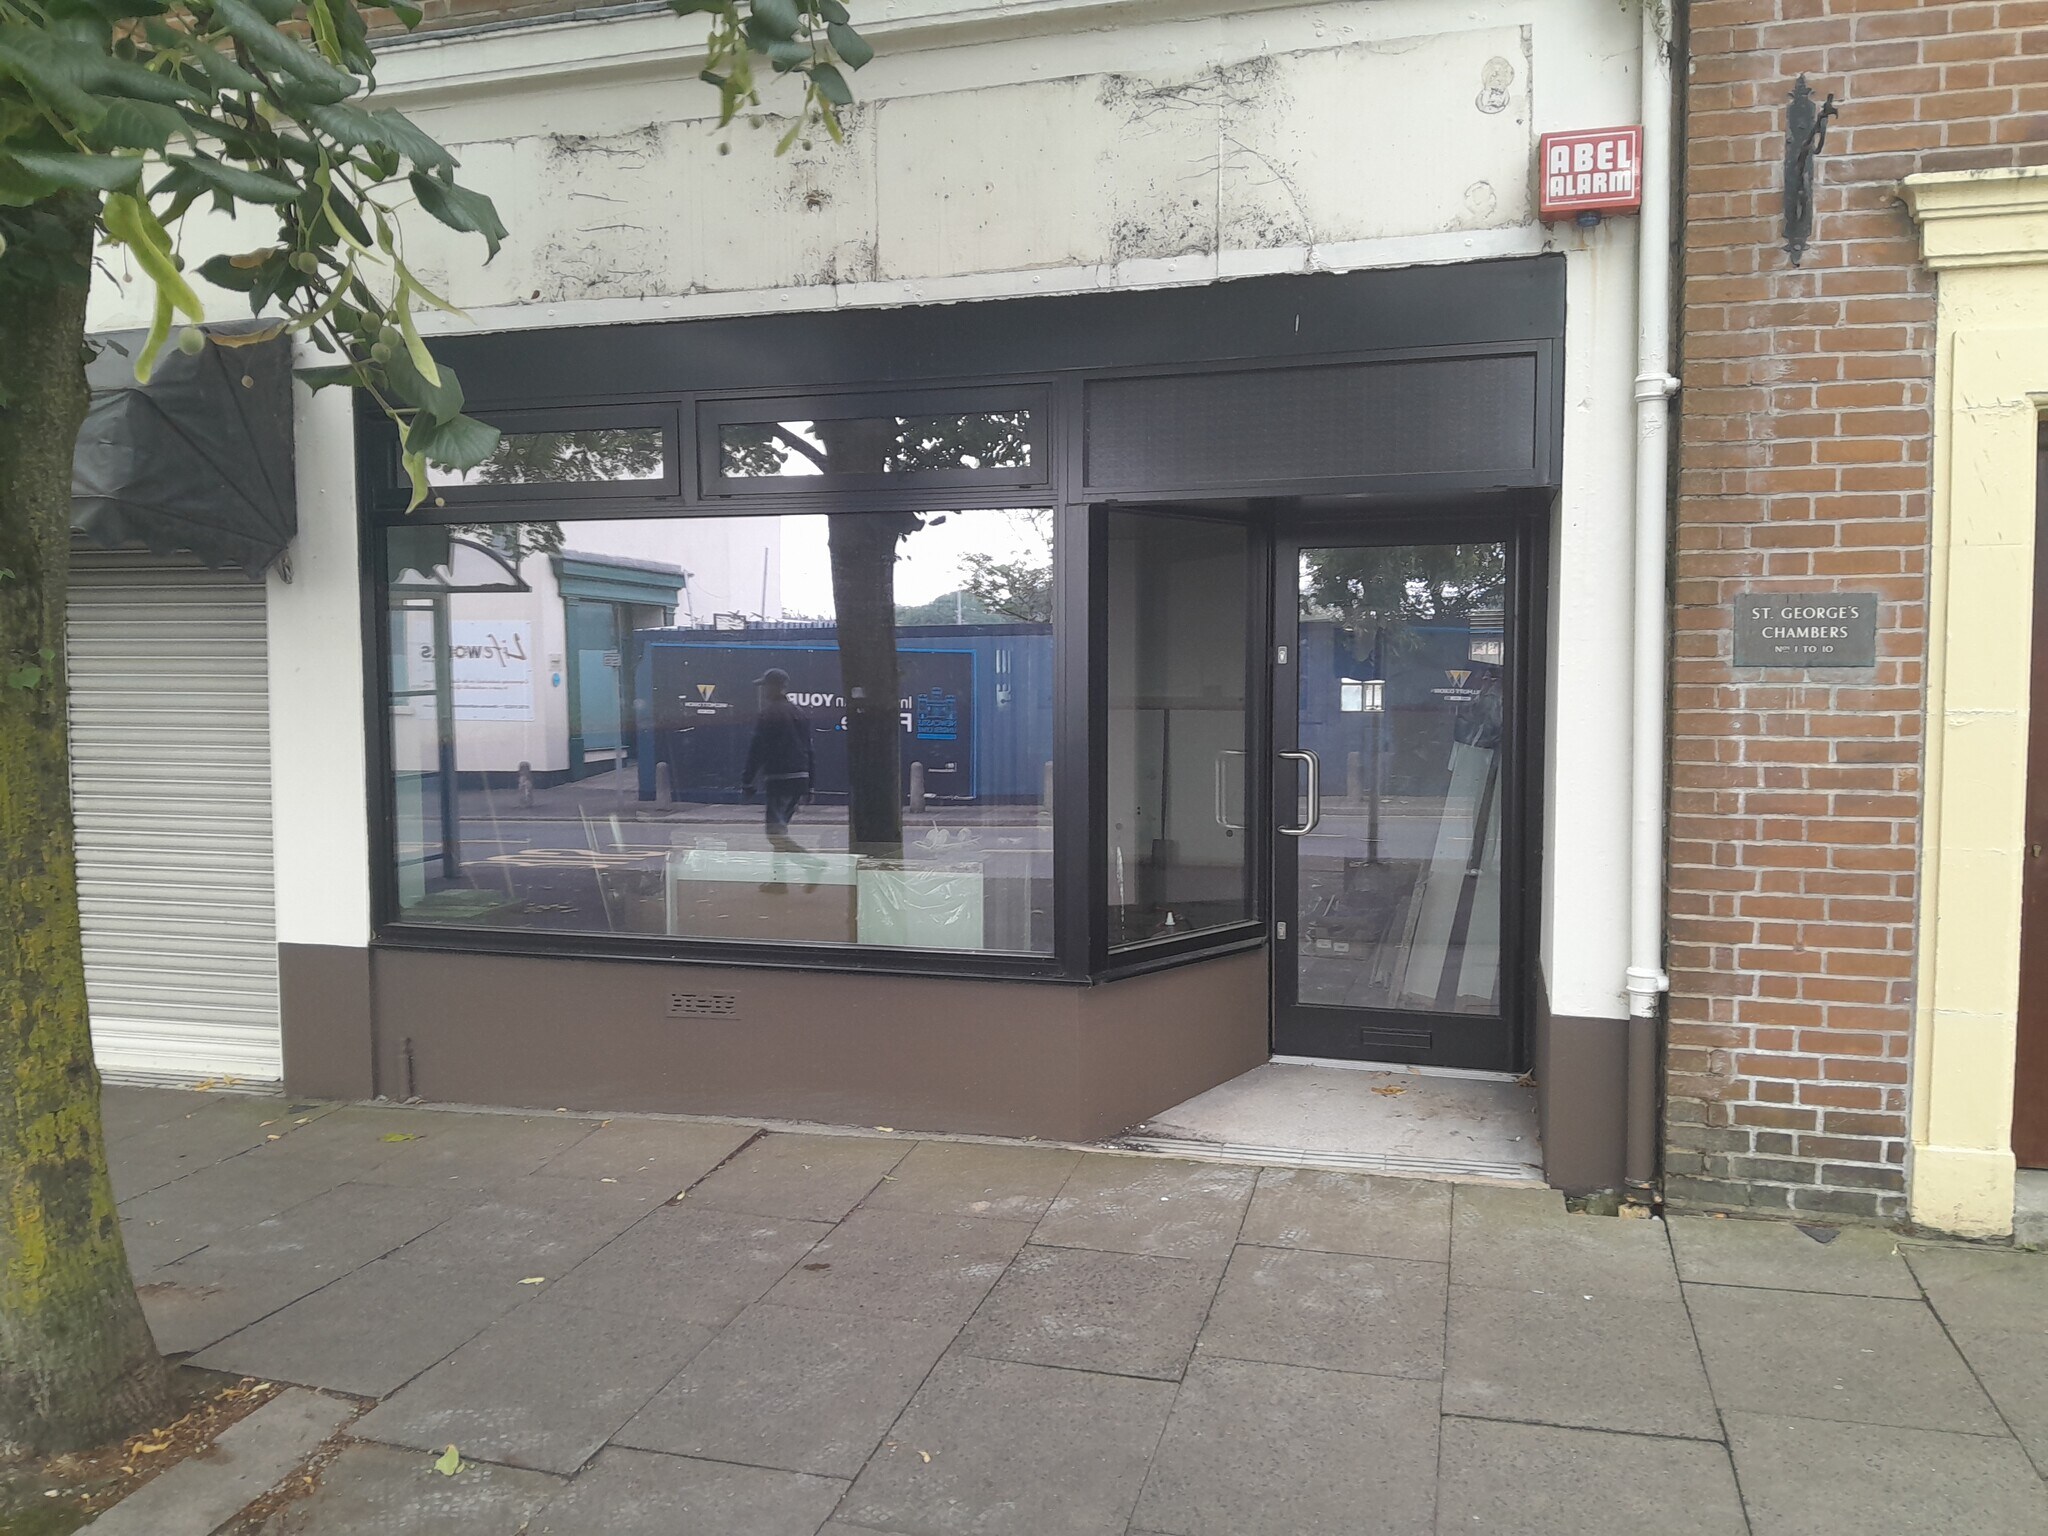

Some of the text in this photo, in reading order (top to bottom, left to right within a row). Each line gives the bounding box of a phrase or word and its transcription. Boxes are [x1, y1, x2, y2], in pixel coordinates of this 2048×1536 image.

[1550, 140, 1631, 175] ABEL
[1550, 170, 1632, 197] ALARM
[1751, 605, 1860, 620] ST. GEORGE'S
[1761, 626, 1849, 639] CHAMBERS
[1802, 645, 1818, 653] TO
[1821, 645, 1834, 653] 10
